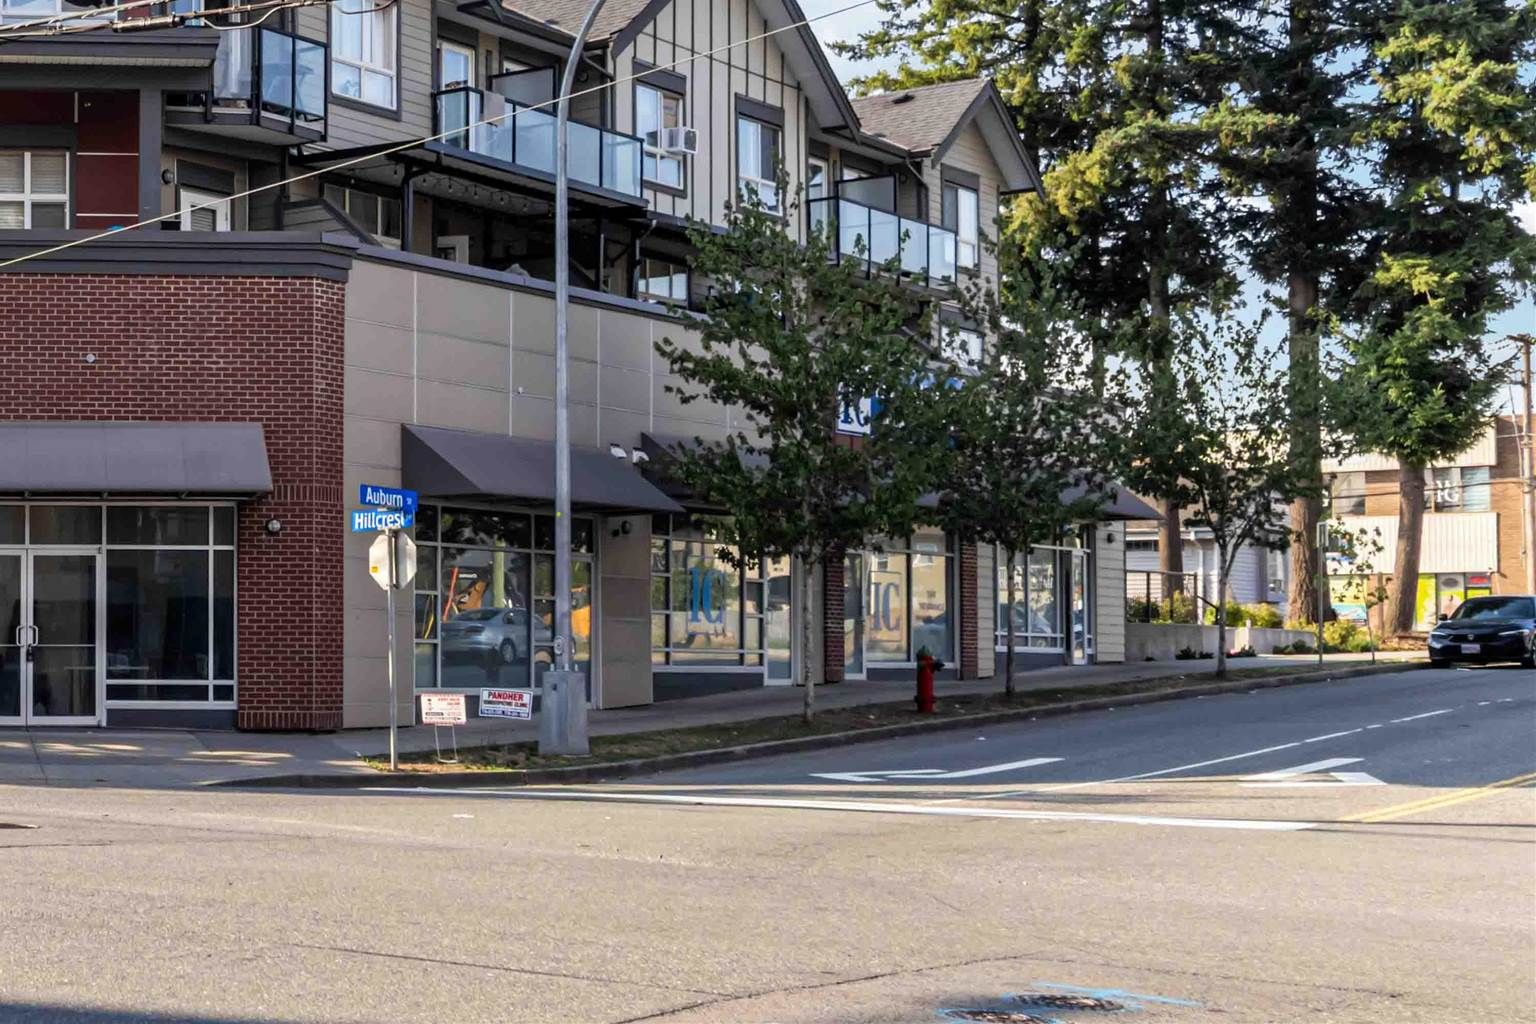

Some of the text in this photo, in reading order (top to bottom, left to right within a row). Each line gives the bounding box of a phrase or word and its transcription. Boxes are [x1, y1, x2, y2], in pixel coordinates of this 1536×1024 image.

[366, 487, 403, 507] Auburn
[355, 511, 405, 530] Hillcrest
[488, 691, 524, 702] PANDHER
